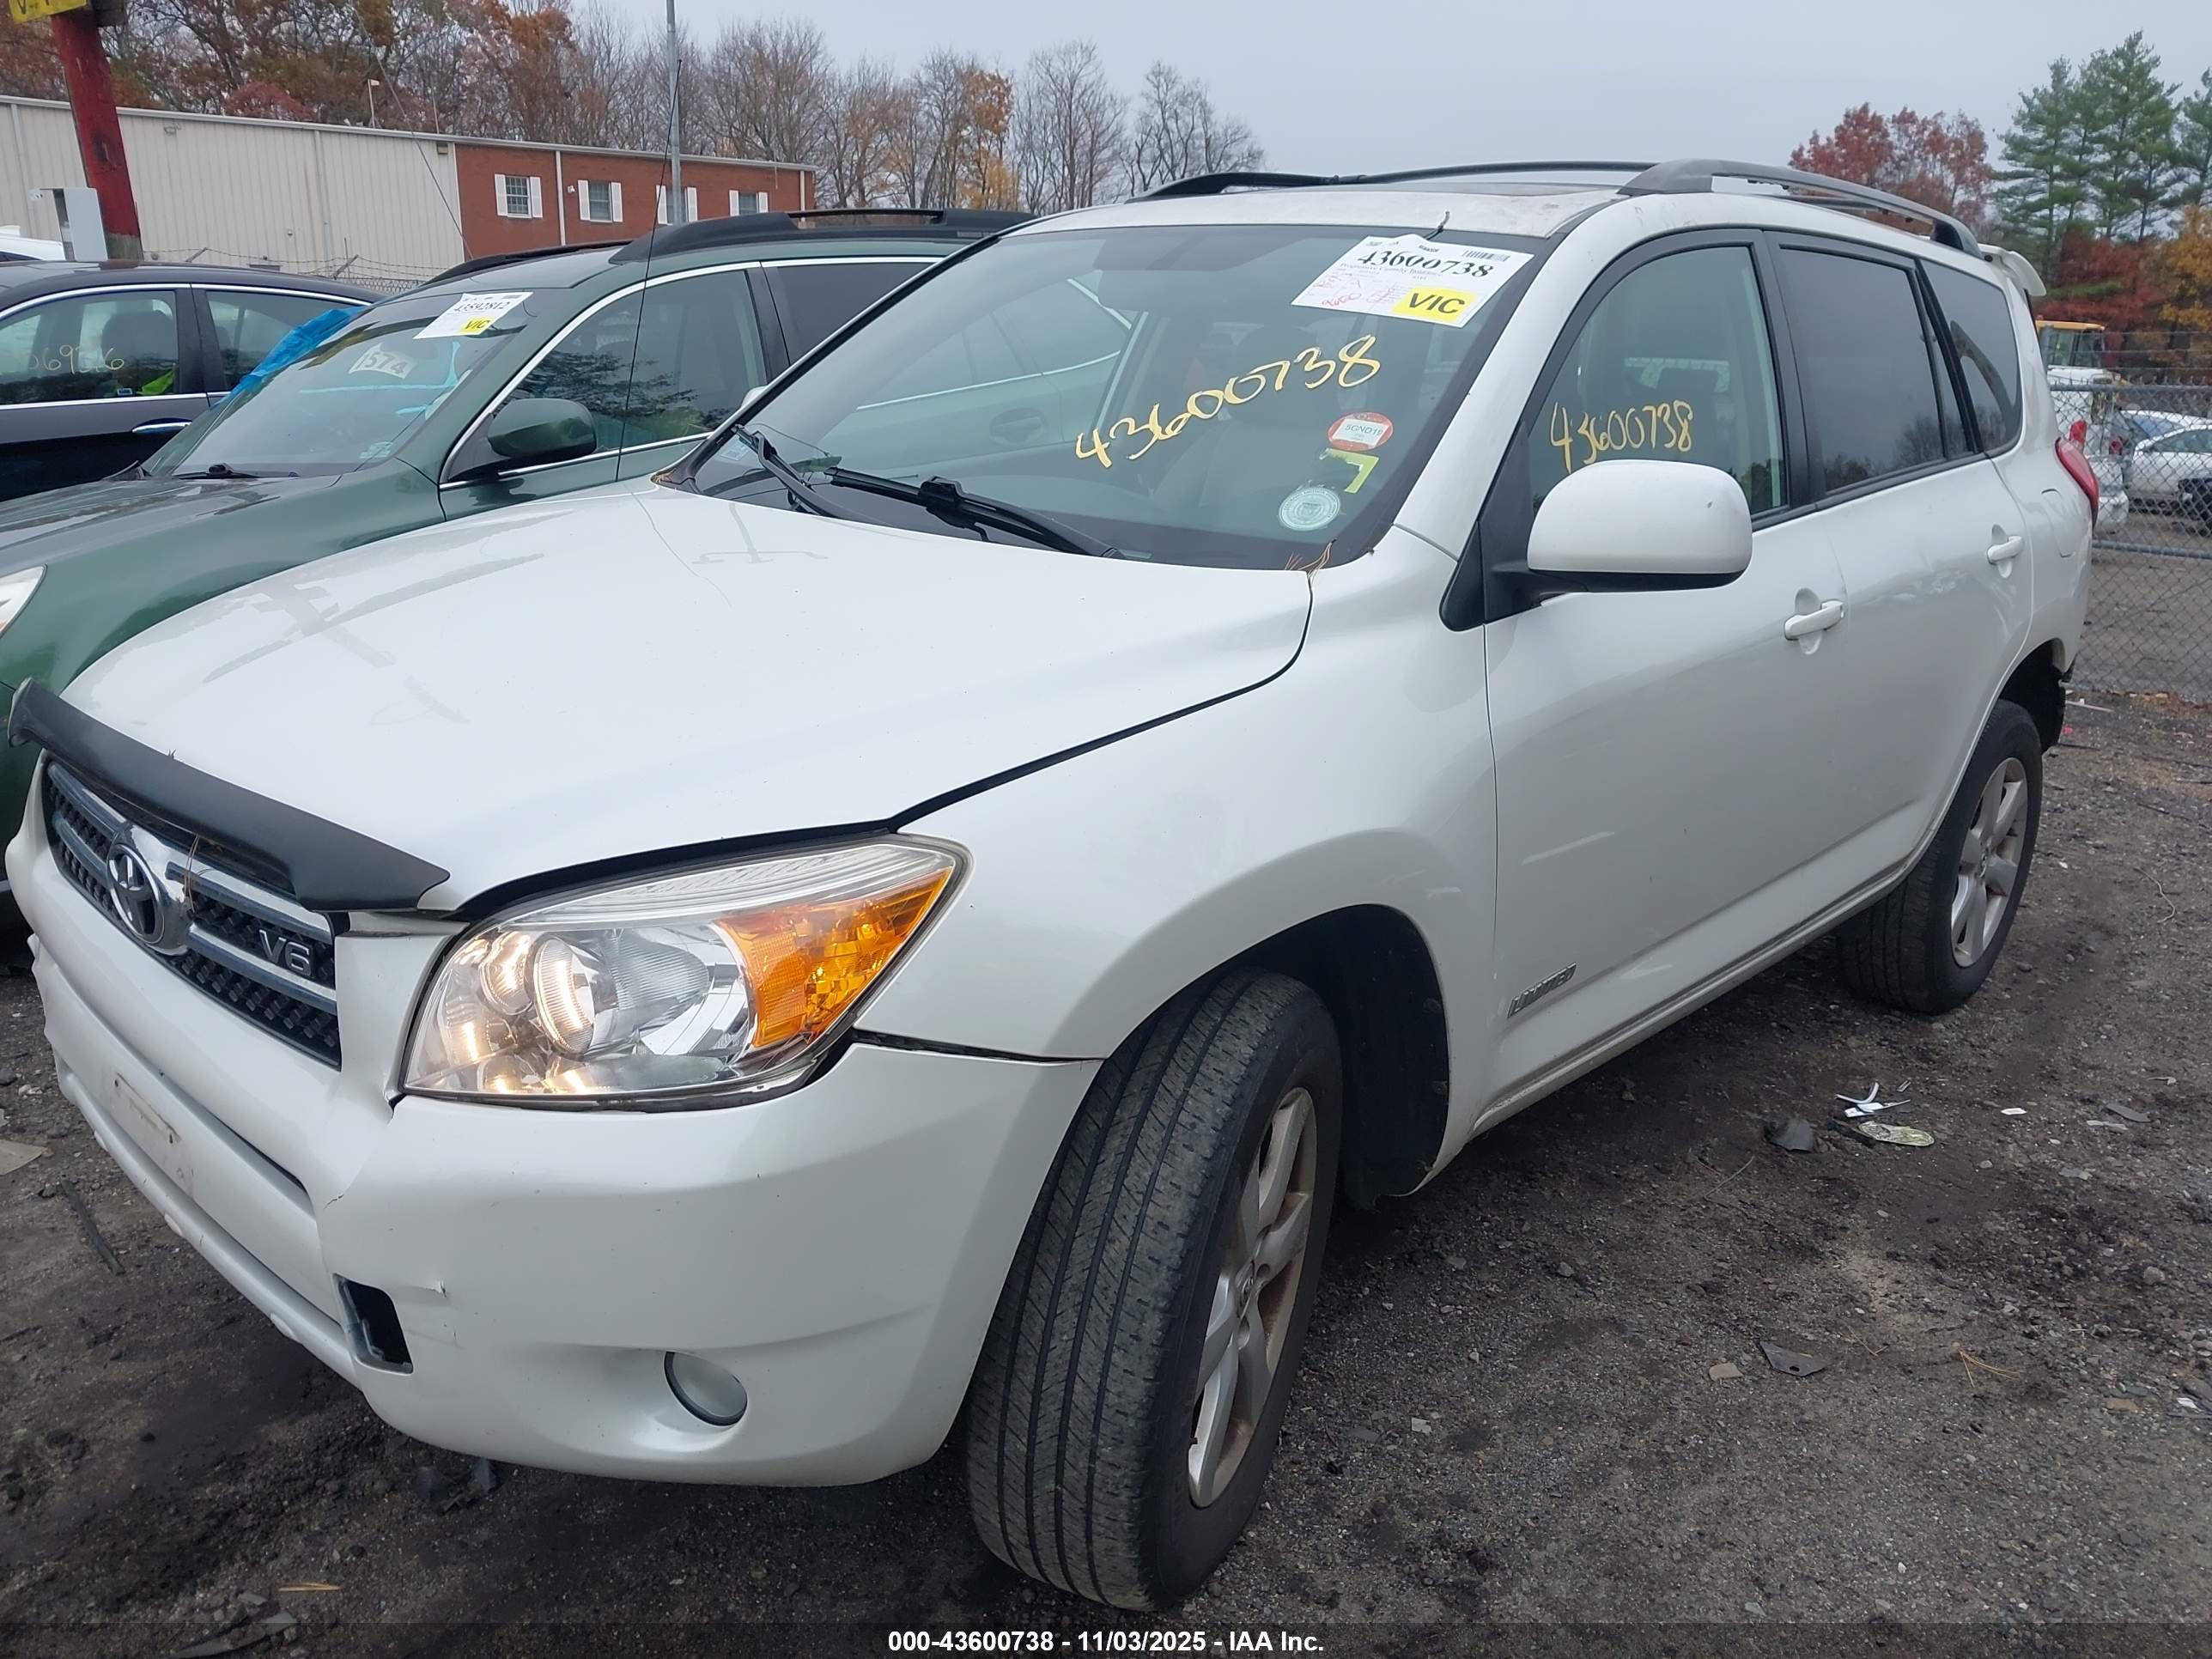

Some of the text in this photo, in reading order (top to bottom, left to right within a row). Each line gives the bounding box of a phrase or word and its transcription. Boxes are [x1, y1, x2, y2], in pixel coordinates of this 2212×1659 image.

[1357, 249, 1494, 279] 43600738
[1408, 292, 1466, 315] VIC
[465, 319, 491, 331] VIC
[1075, 334, 1381, 469] 43600738
[1550, 399, 1693, 475] 43600738
[258, 928, 313, 977] V6
